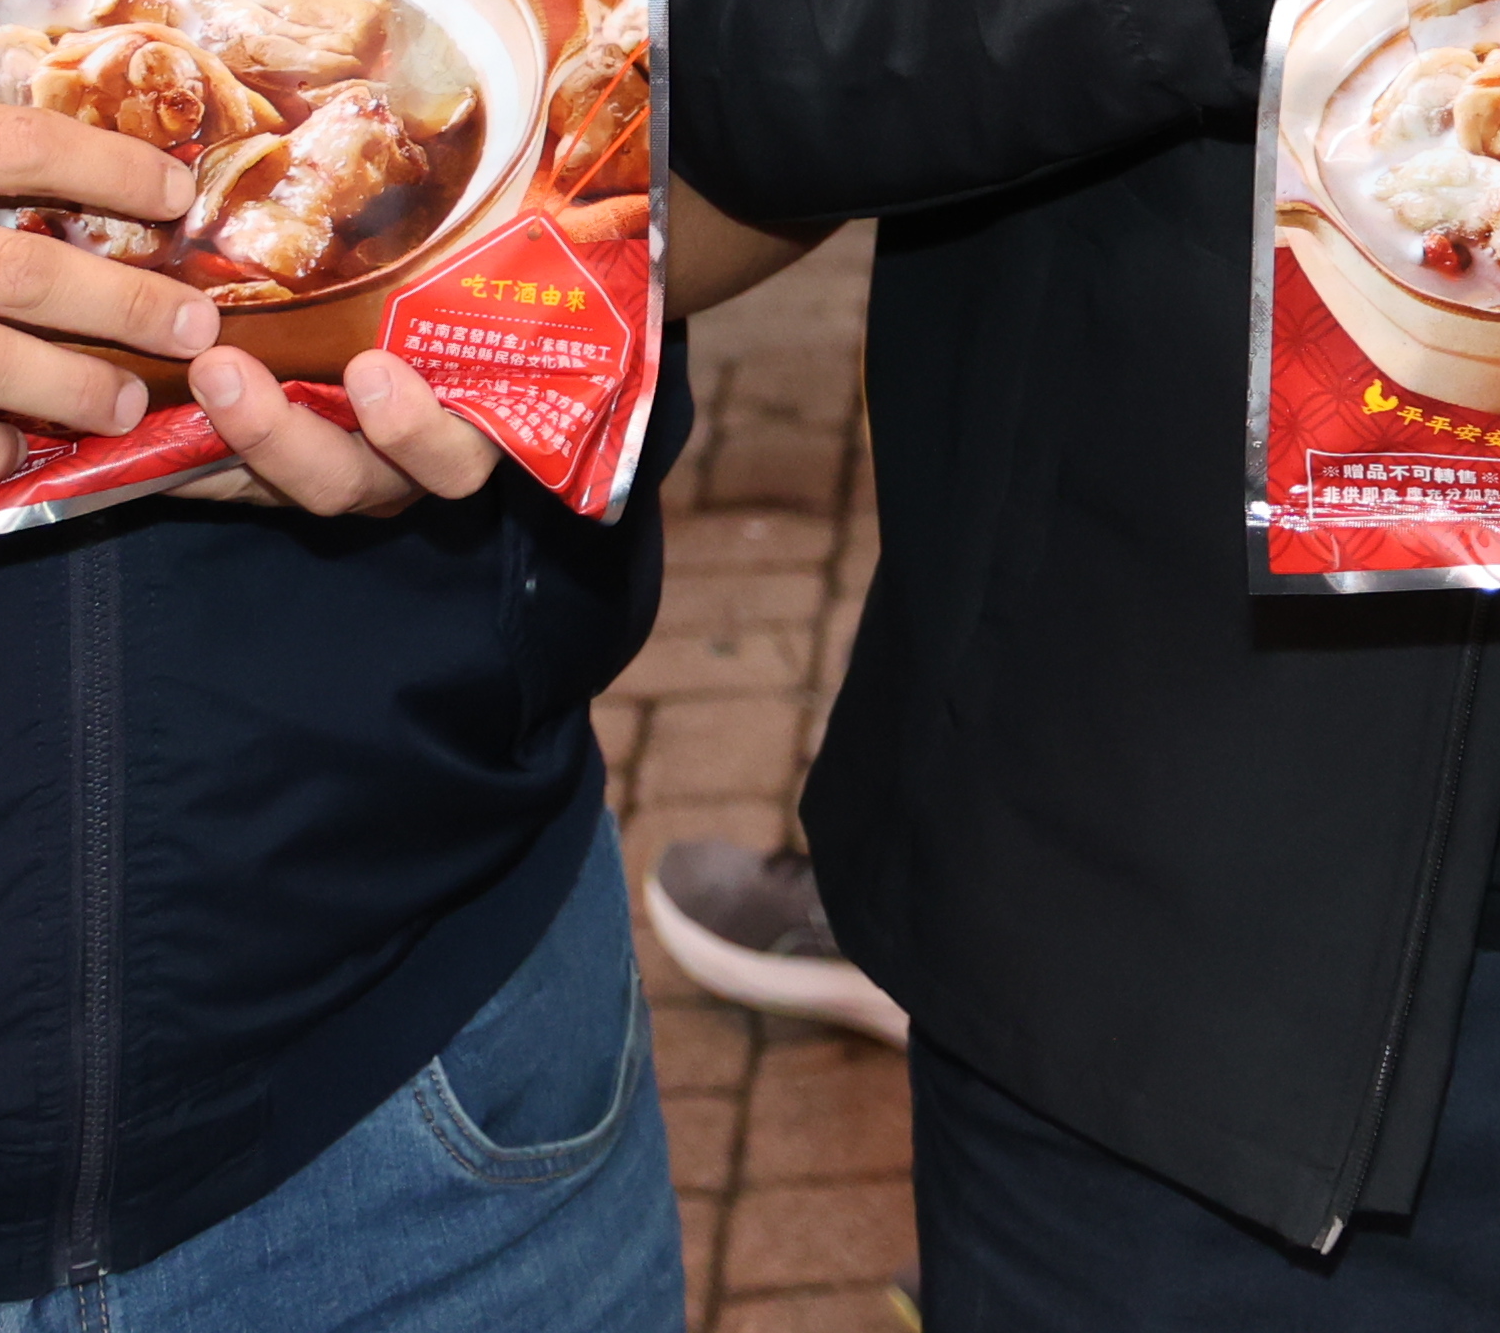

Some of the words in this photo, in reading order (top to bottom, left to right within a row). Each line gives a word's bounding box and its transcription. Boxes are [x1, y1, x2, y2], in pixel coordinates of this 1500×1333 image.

[460, 273, 587, 313] 吃丁酒由來
